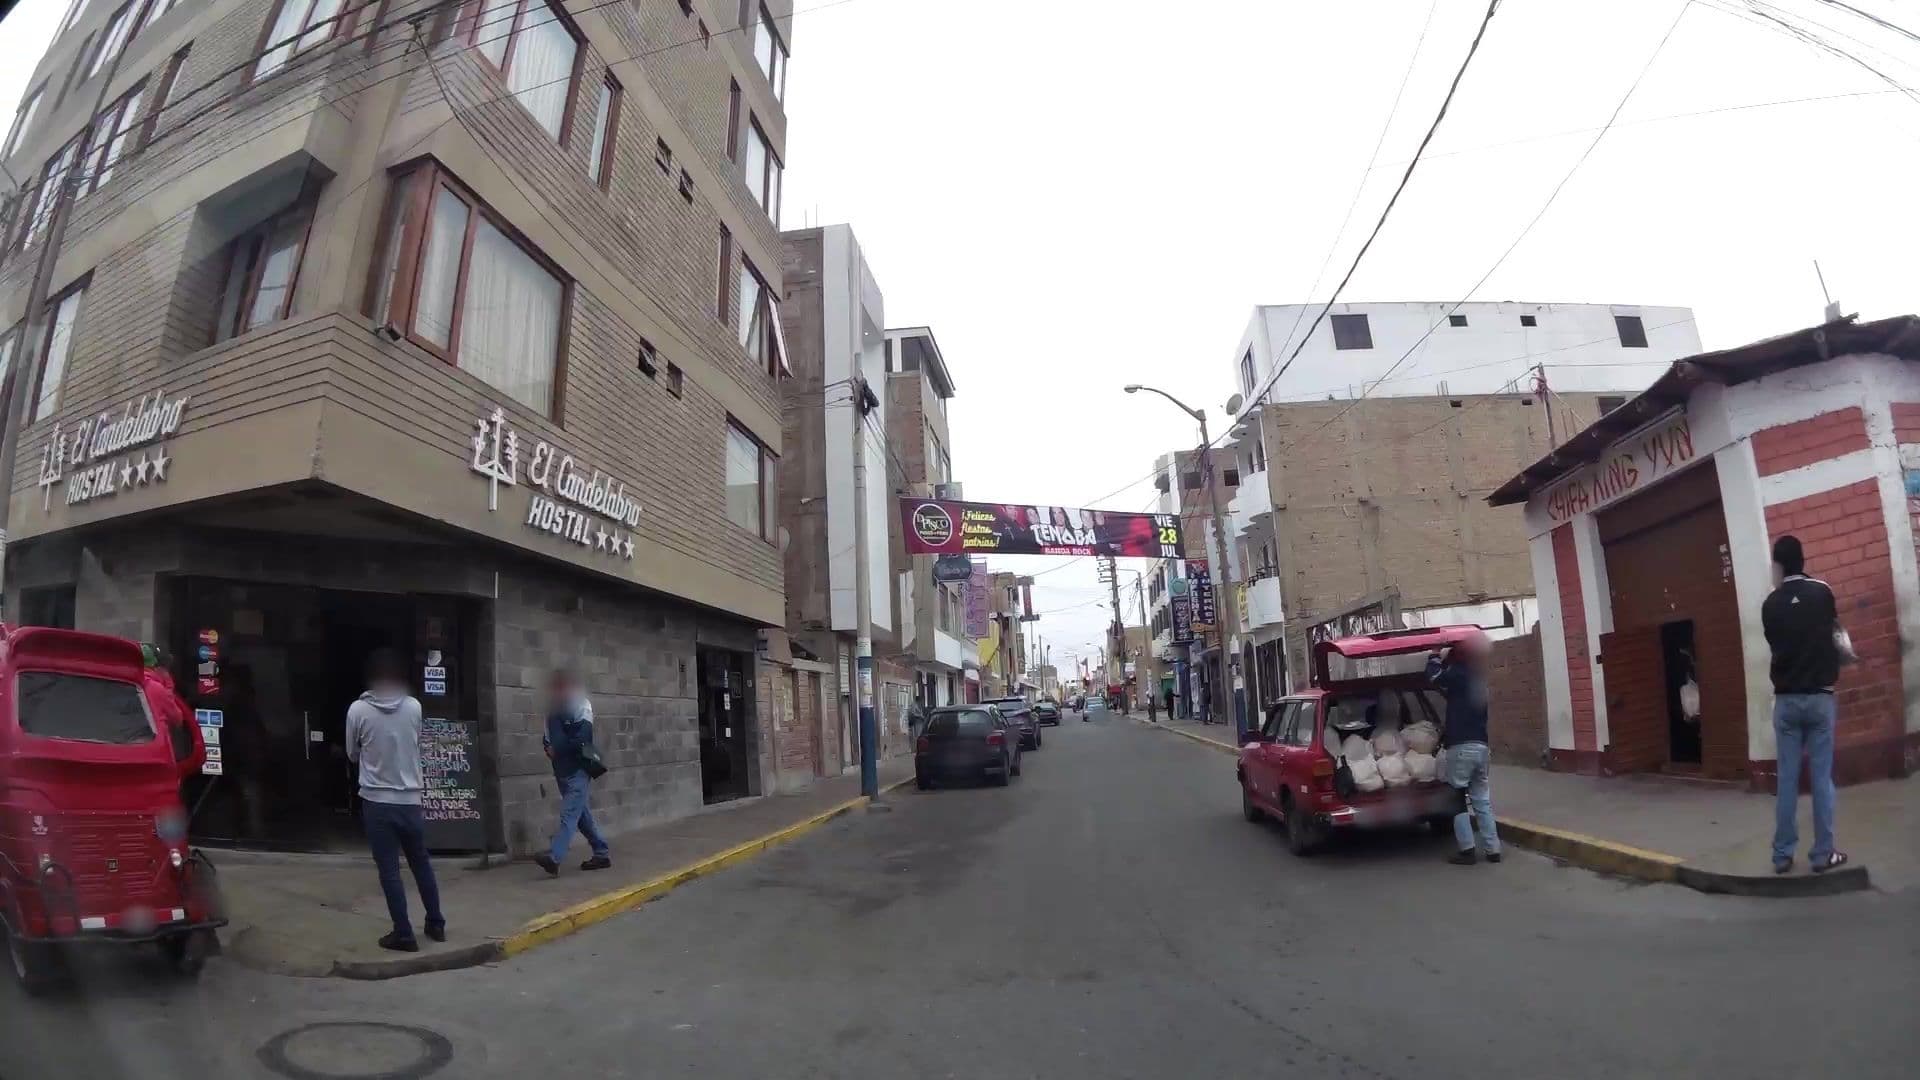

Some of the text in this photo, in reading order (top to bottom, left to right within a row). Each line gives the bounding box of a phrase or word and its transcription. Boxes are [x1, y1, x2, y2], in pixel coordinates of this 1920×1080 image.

[71, 419, 92, 464] El
[65, 461, 116, 504] HOSTAL
[530, 442, 642, 527] El Candelabro
[1593, 454, 1639, 504] NING
[528, 496, 591, 545] HOSTAL
[1159, 528, 1178, 544] 28
[1161, 544, 1180, 558] JUL
[427, 669, 444, 677] VISA
[427, 682, 444, 691] VISA
